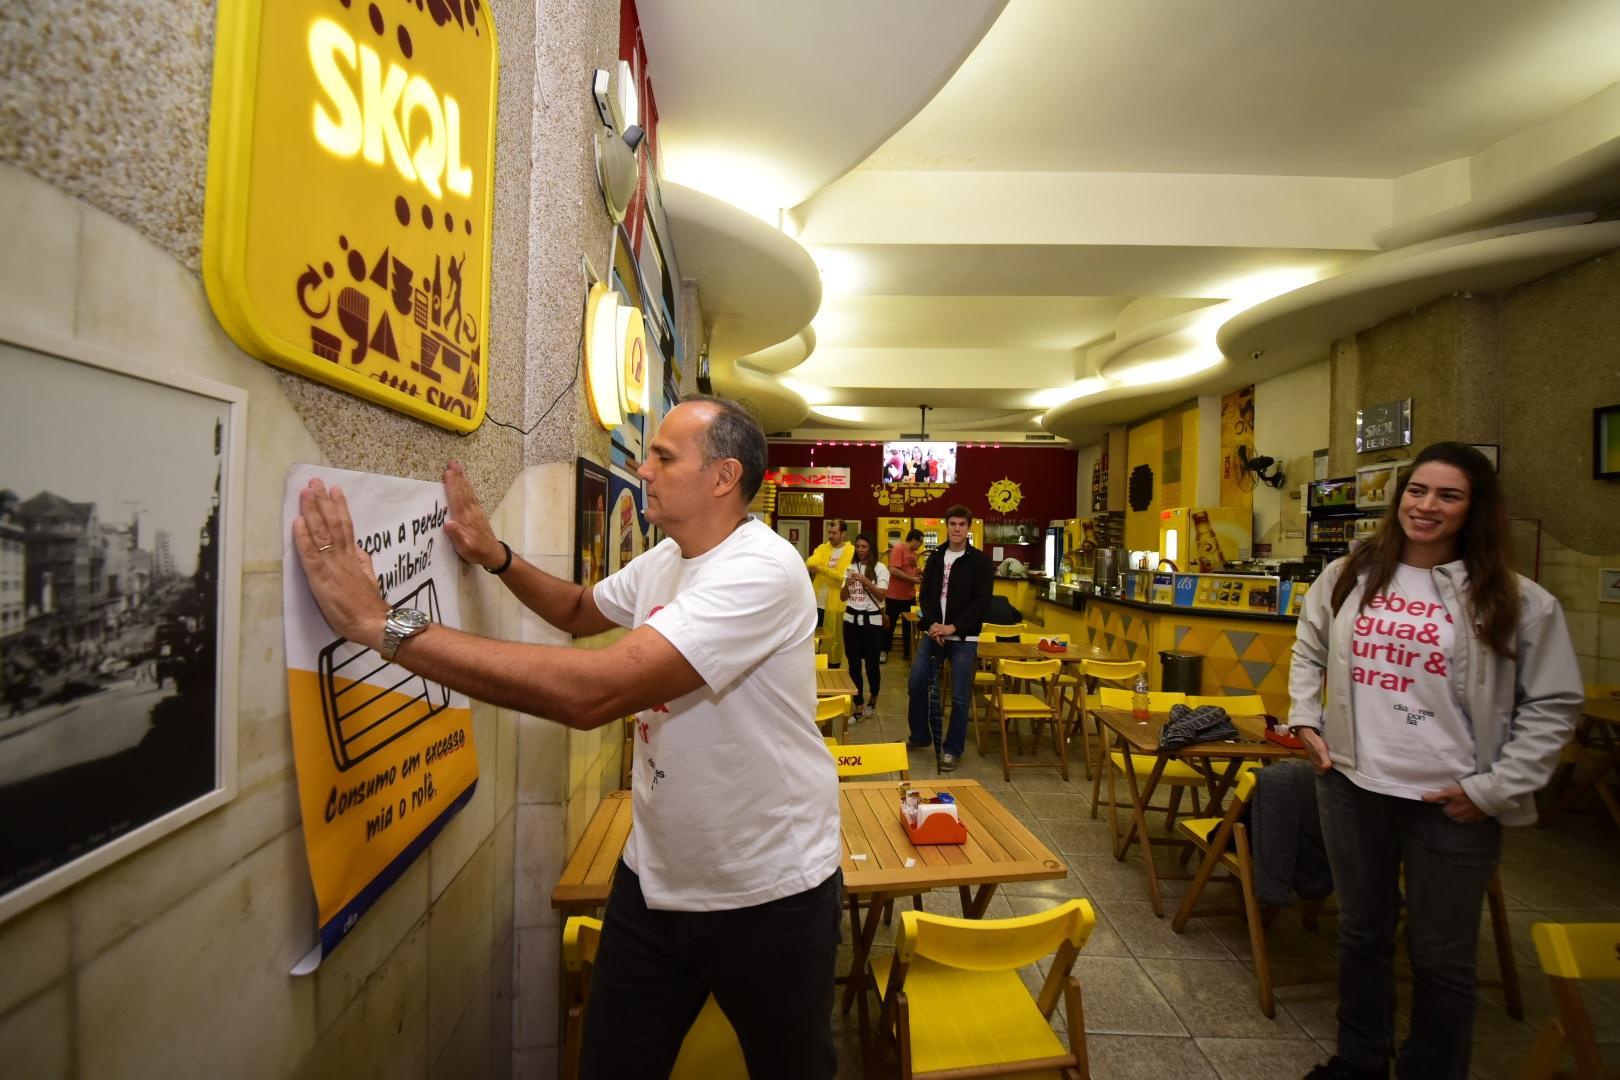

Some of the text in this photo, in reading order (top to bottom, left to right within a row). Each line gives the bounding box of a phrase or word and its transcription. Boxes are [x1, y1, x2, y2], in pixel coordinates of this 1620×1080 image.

[398, 522, 406, 544] a
[411, 500, 448, 546] perder
[377, 537, 434, 600] quilíbrio?
[1367, 592, 1442, 618] eber
[1354, 615, 1440, 646] gua&
[1352, 640, 1447, 678] urtir &
[1352, 666, 1415, 692] arar
[325, 729, 465, 823] Consumo em excesso
[366, 772, 438, 841] mia o rolê.
